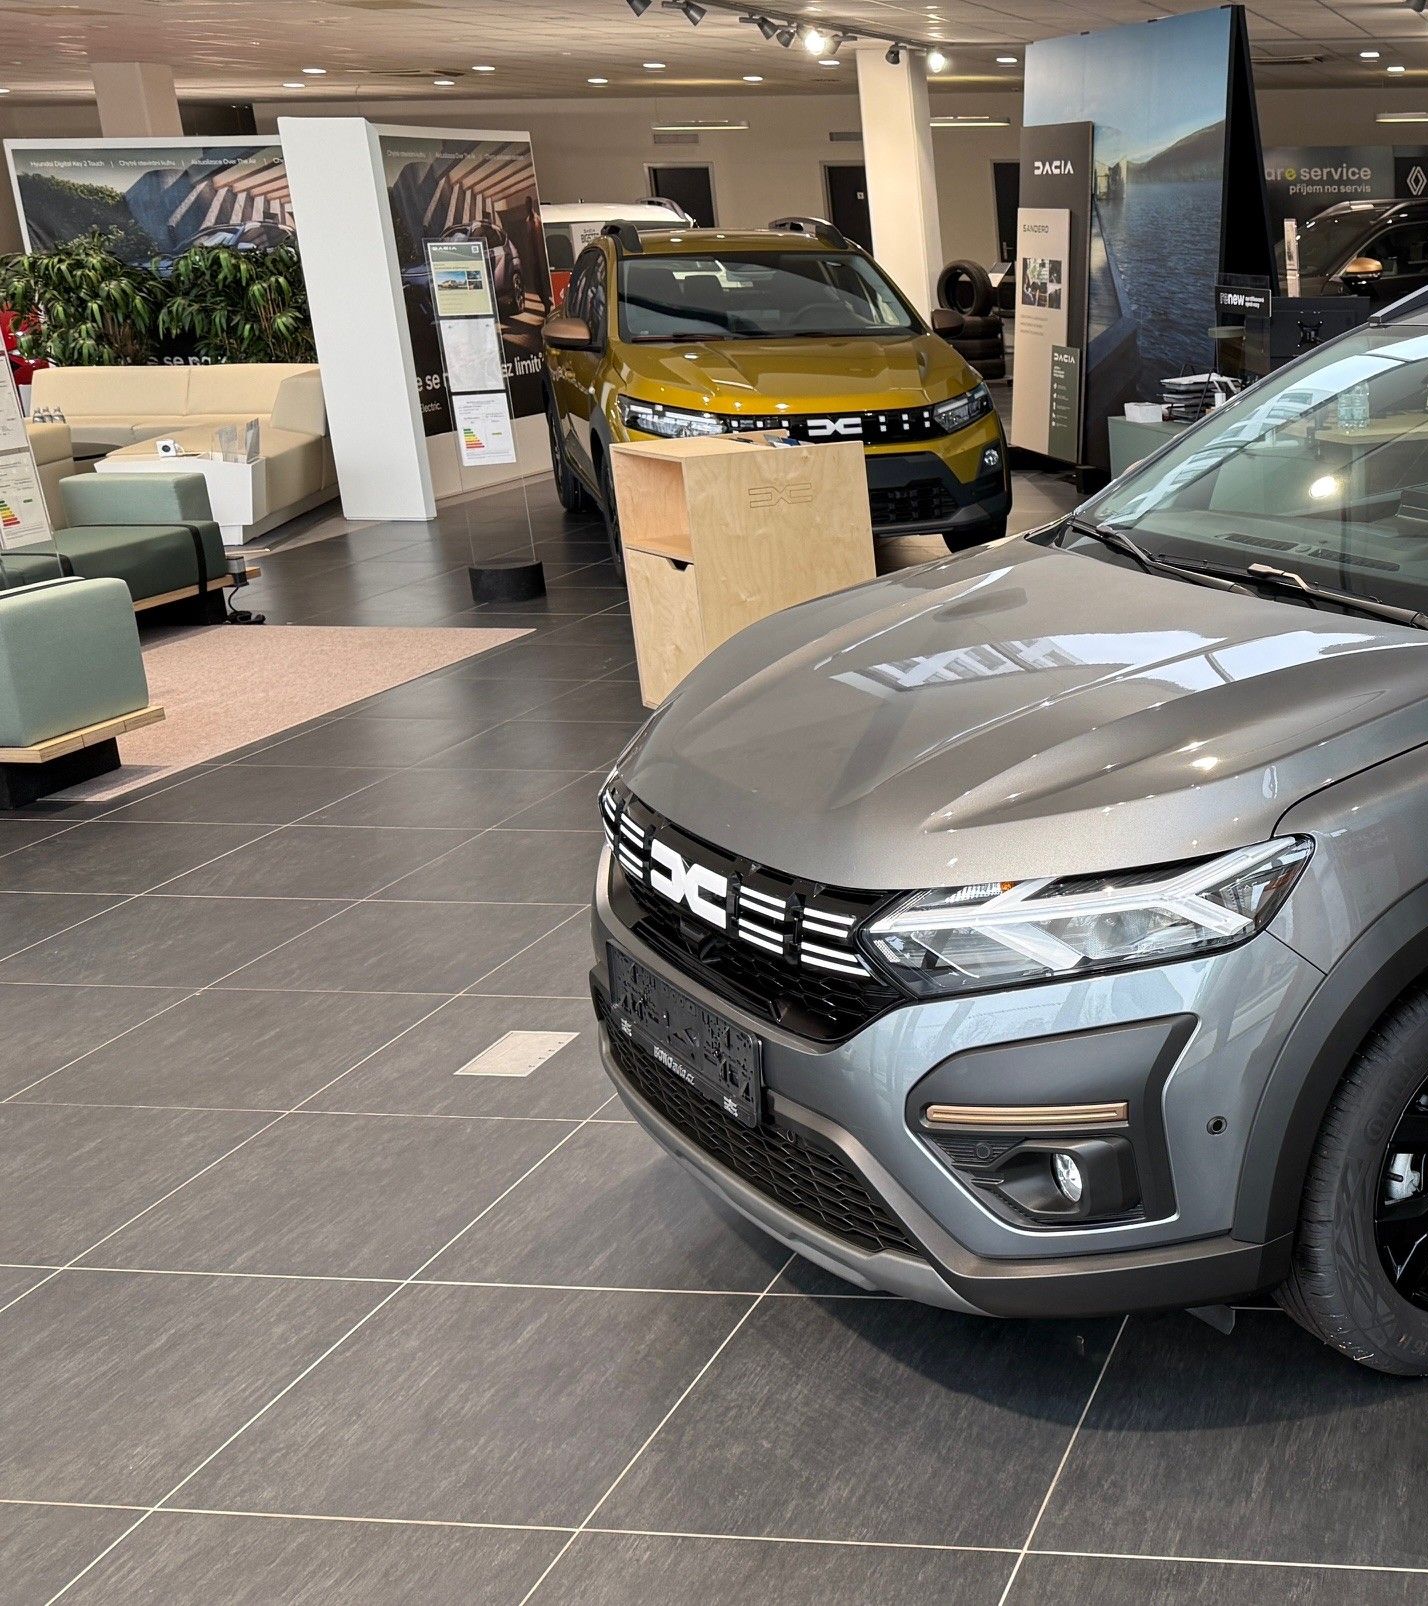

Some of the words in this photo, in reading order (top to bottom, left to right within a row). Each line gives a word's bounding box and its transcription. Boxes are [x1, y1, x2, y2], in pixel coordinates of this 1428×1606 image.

[1034, 161, 1074, 175] DACIA
[1265, 168, 1296, 180] are
[1300, 163, 1371, 180] service
[1290, 184, 1322, 195] příjem
[1340, 184, 1371, 193] servis
[1023, 225, 1049, 234] SANDERO
[1220, 293, 1244, 306] renew
[1054, 353, 1075, 363] DACIA
